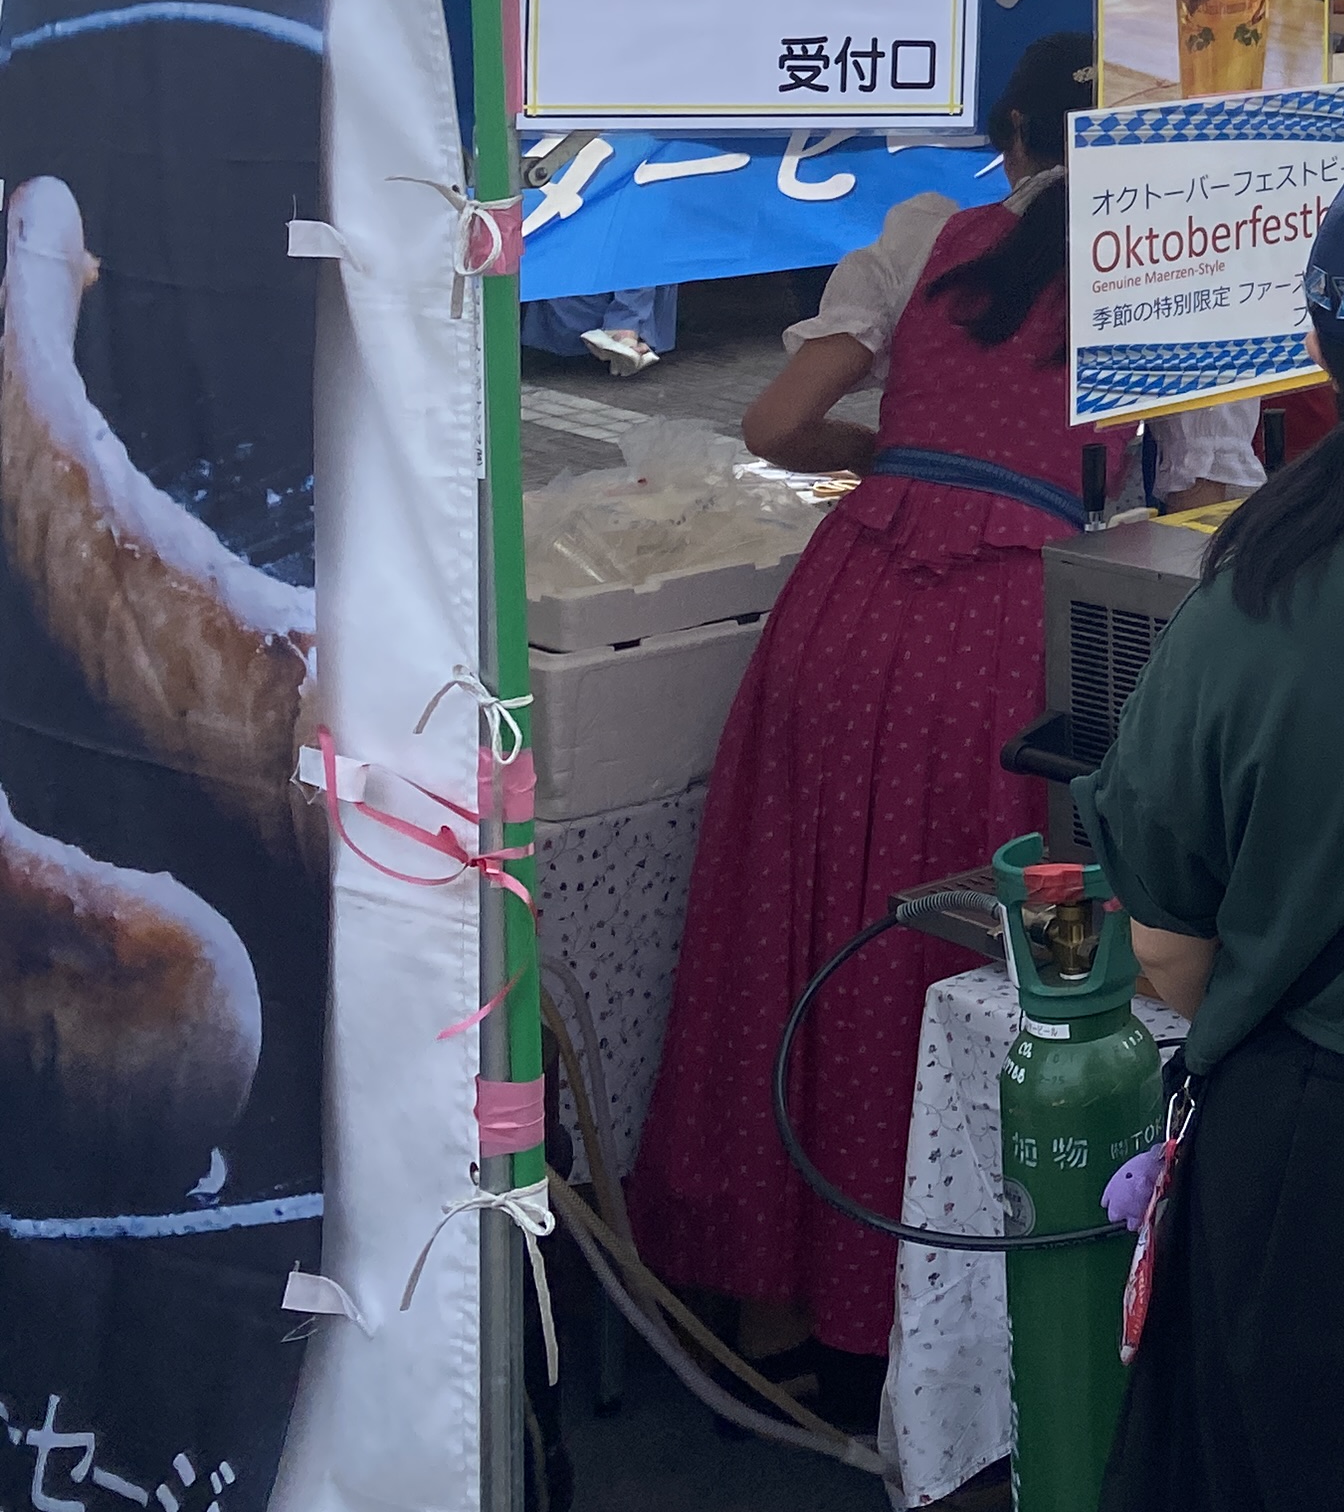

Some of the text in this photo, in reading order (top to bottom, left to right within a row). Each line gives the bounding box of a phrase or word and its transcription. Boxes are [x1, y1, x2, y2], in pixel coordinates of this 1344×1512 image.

[778, 36, 937, 93] 受付口
[1092, 260, 1226, 294] Genuine Maerzen-Style
[1092, 286, 1231, 331] 季節の特別限定
